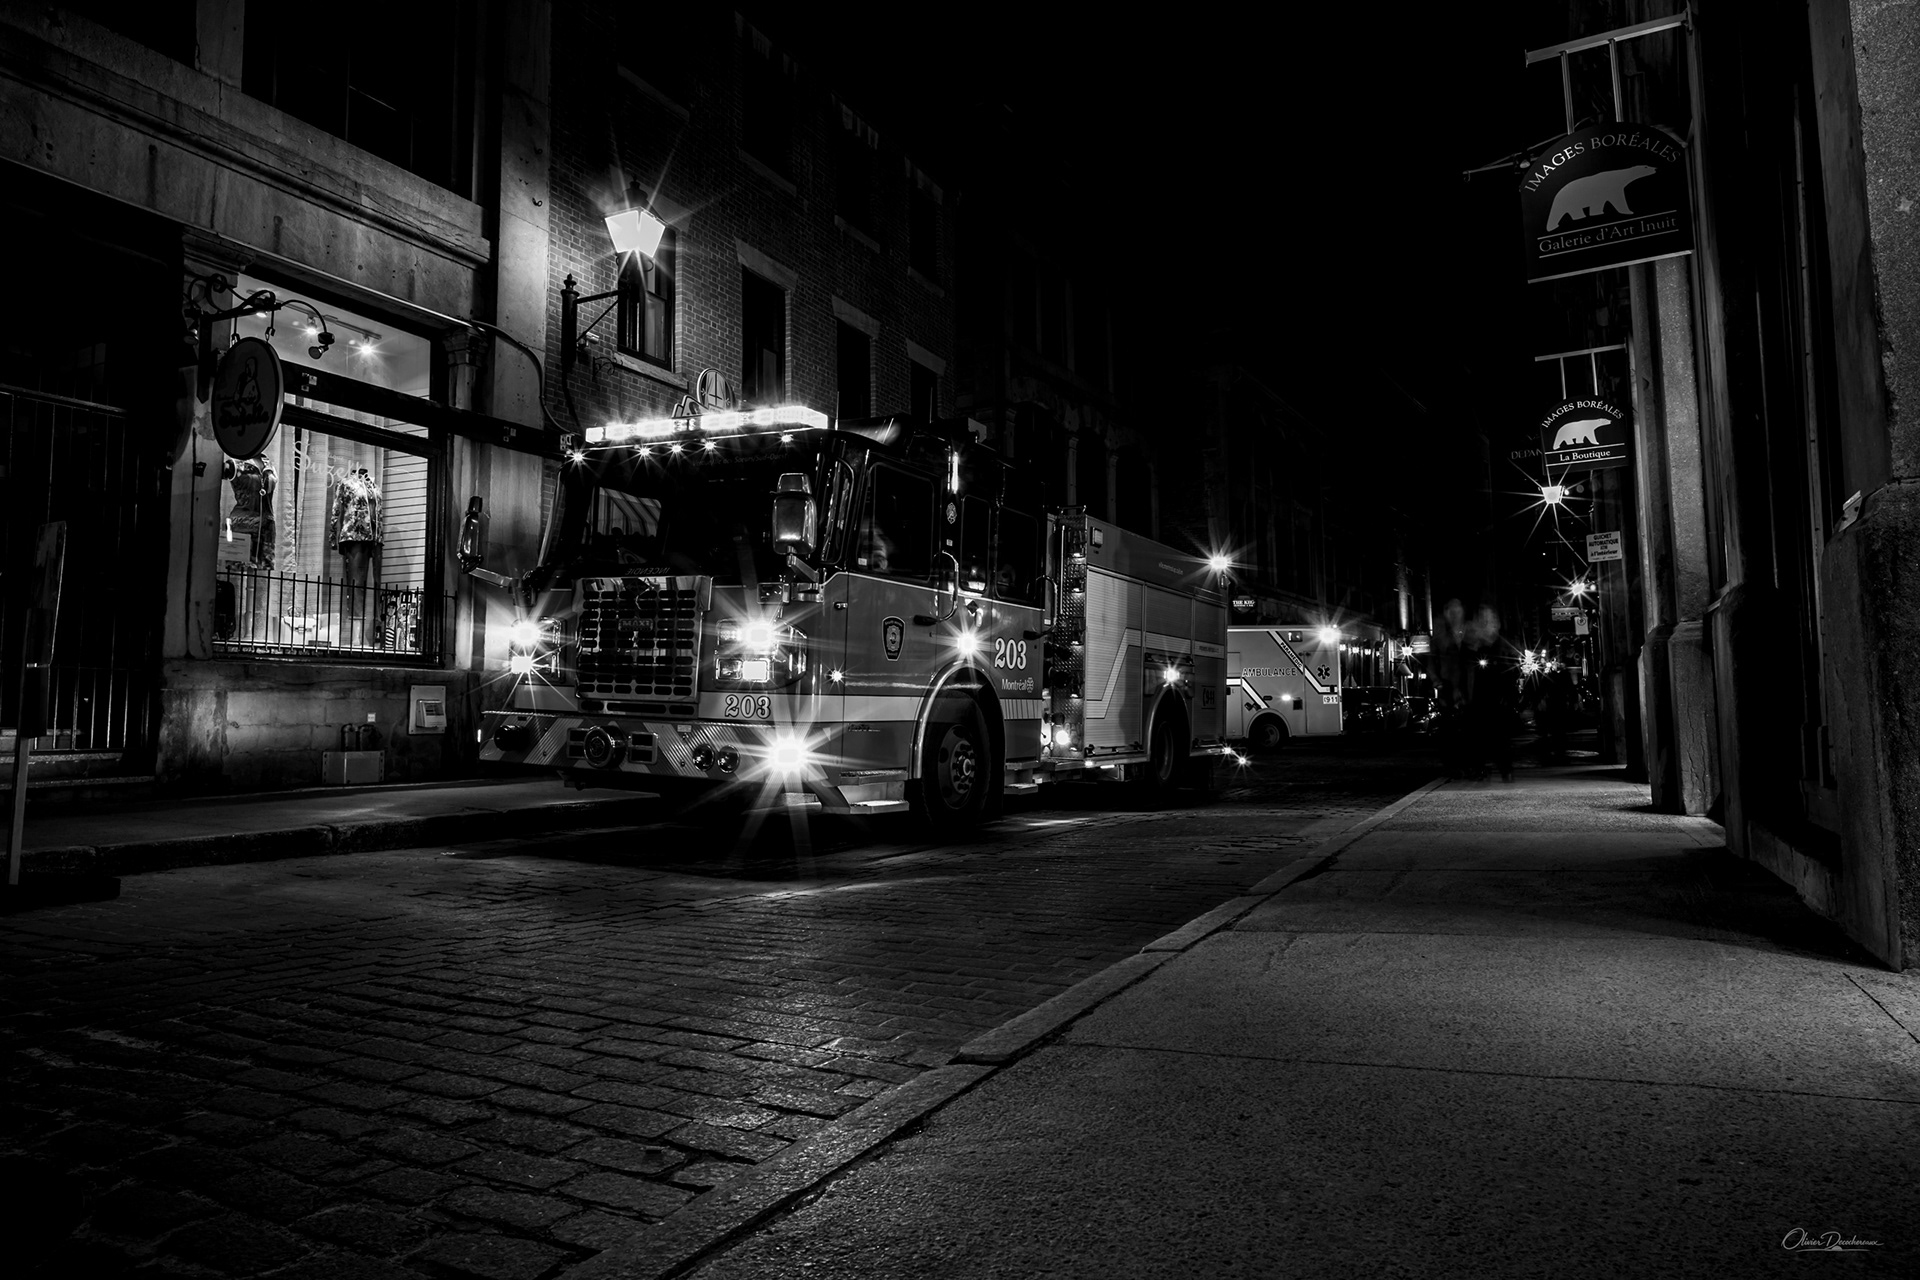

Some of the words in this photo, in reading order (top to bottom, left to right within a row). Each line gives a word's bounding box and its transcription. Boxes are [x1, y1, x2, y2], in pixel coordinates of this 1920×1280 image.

[1524, 142, 1586, 193] IMAGES
[1590, 131, 1681, 163] BORÉALES
[1539, 233, 1592, 253] Galerie
[1596, 224, 1635, 242] d'Art
[1640, 217, 1677, 233] Inuit
[1541, 403, 1575, 429] IMAGES
[1577, 400, 1625, 420] BORÉALES
[1560, 454, 1570, 462] La
[1572, 450, 1611, 461] Boutique
[994, 637, 1027, 670] 203
[1242, 667, 1298, 678] AMBULANCE
[724, 694, 771, 720] 203
